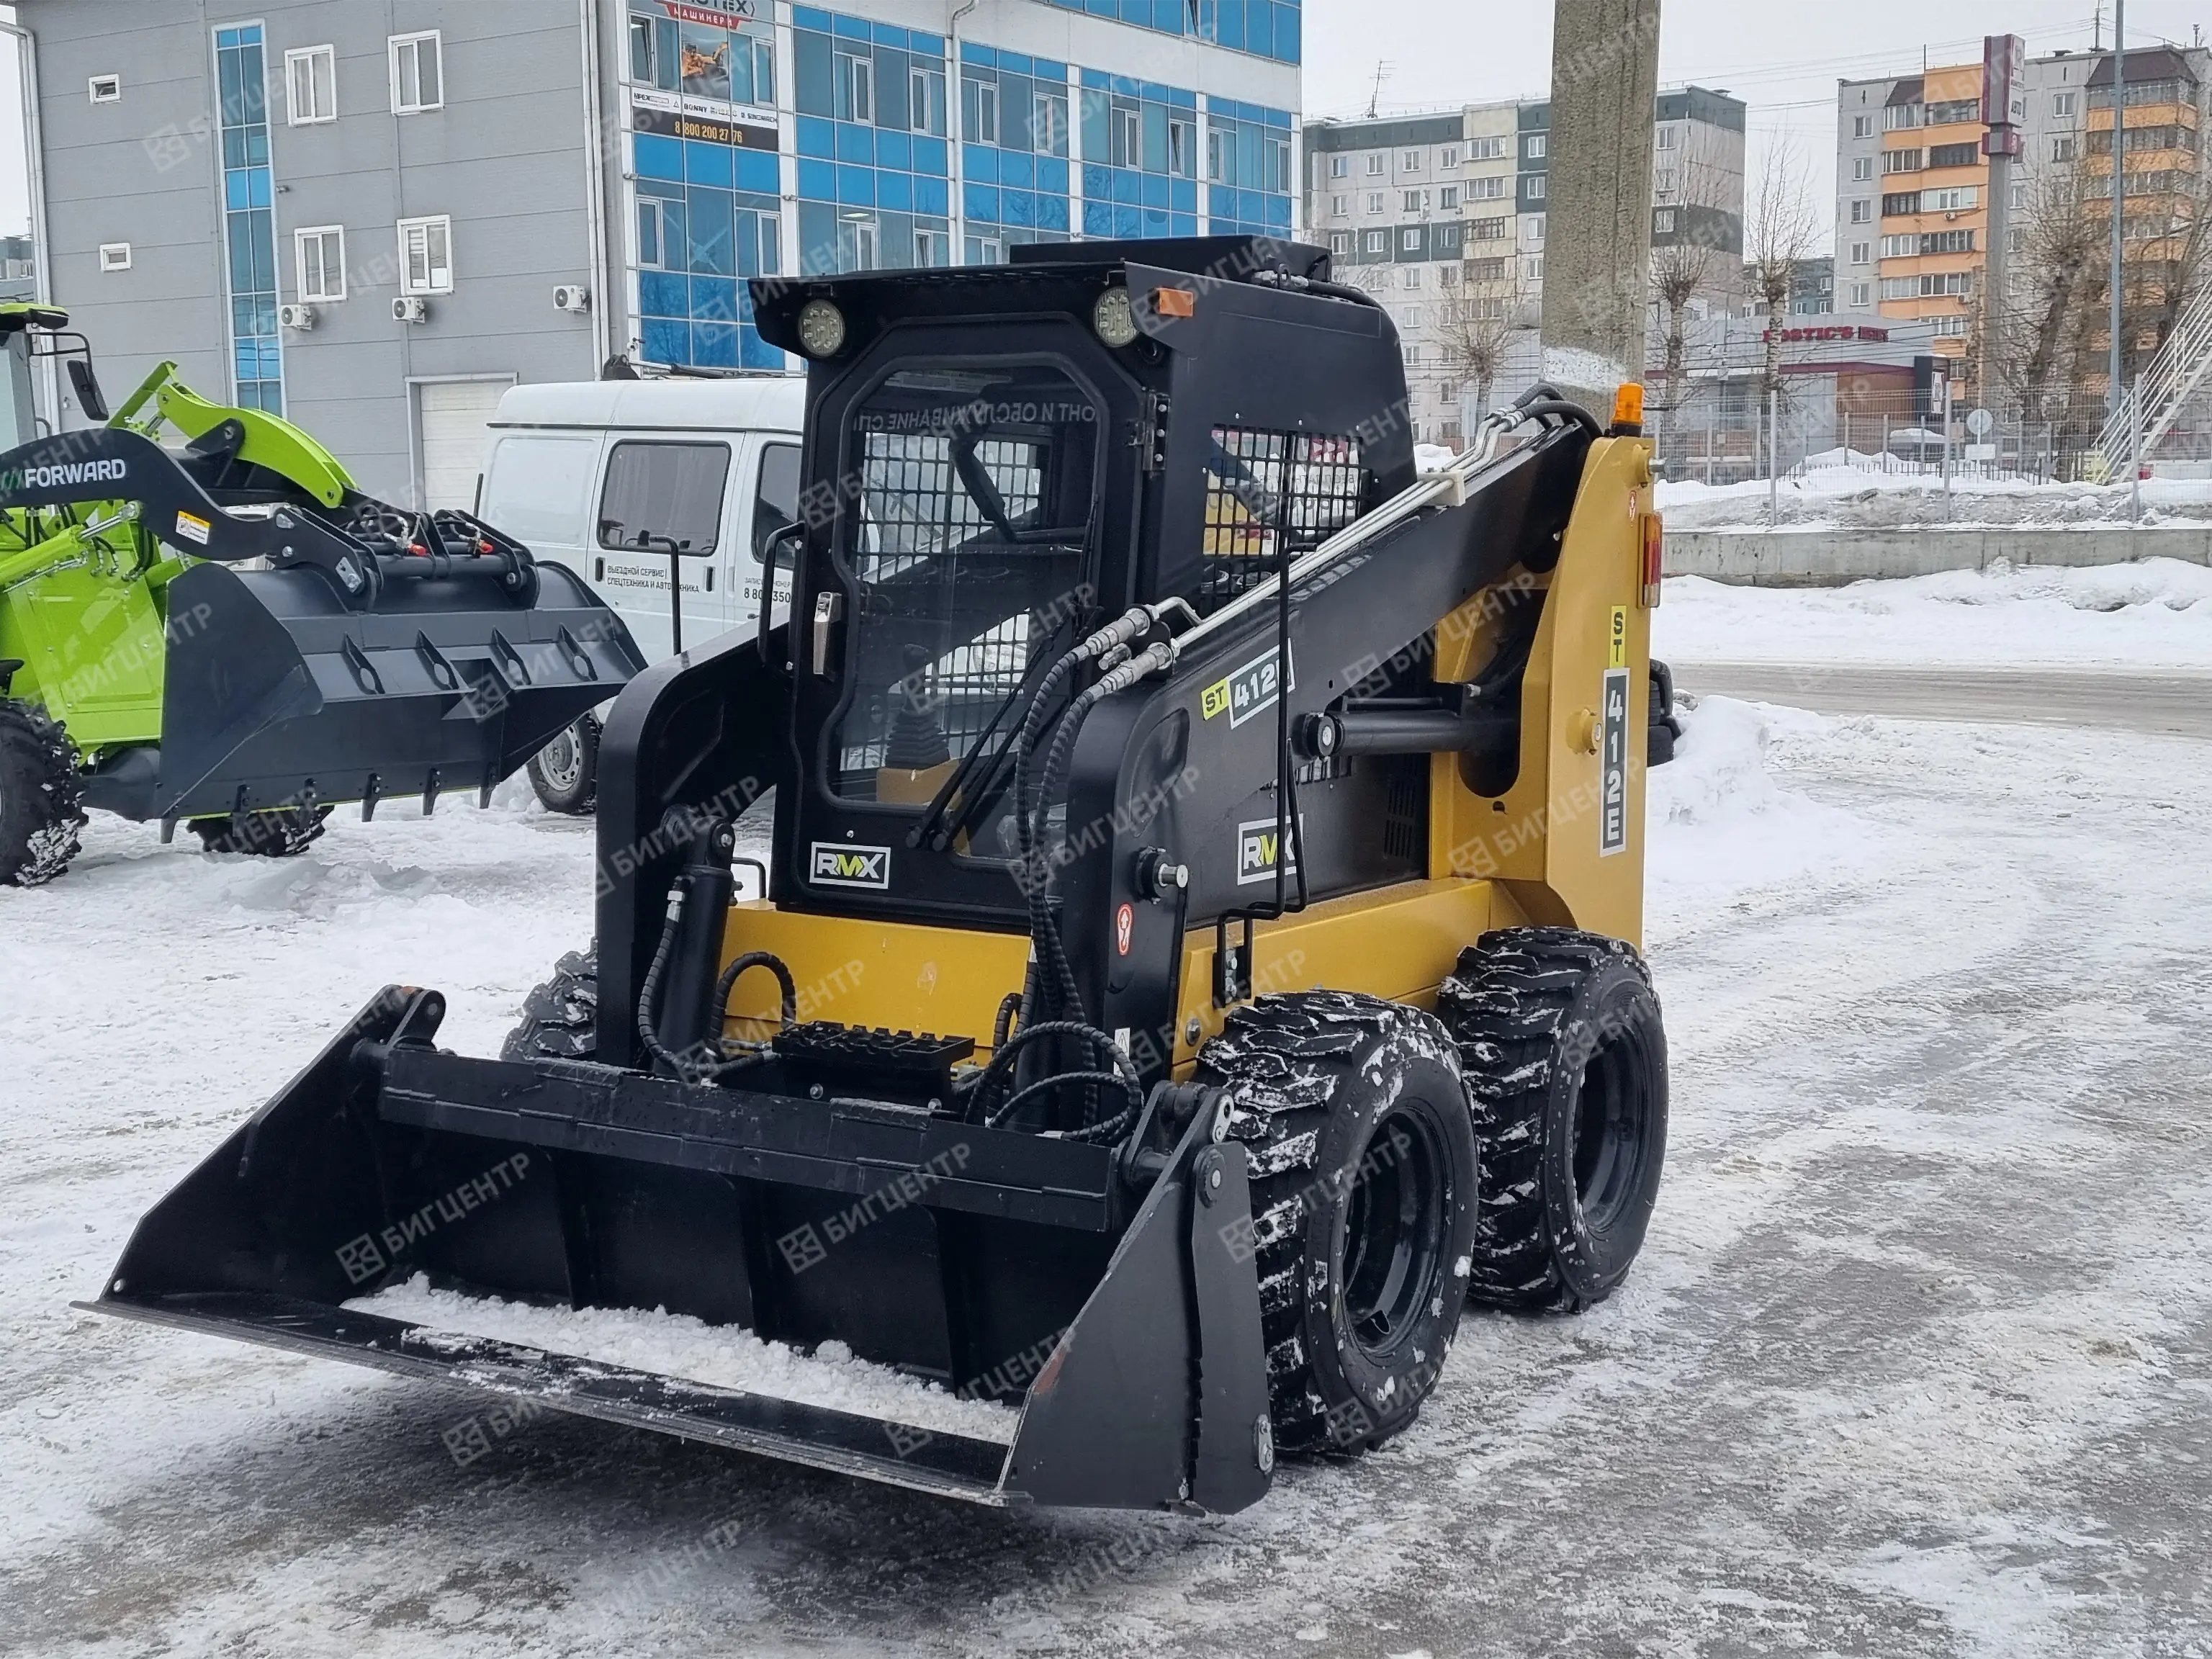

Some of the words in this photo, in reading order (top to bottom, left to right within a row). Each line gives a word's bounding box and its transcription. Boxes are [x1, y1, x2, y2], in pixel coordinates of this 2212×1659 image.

[675, 121, 680, 134] 8
[684, 123, 700, 137] 800
[701, 125, 718, 140] 200
[719, 128, 729, 142] 27
[732, 130, 742, 143] 76
[24, 459, 126, 489] FORWARD
[744, 588, 750, 598] 8
[752, 588, 763, 600] 80
[1612, 611, 1623, 663] ST
[1205, 685, 1224, 712] ST
[1606, 688, 1623, 842] 412E
[817, 852, 884, 879] RMX
